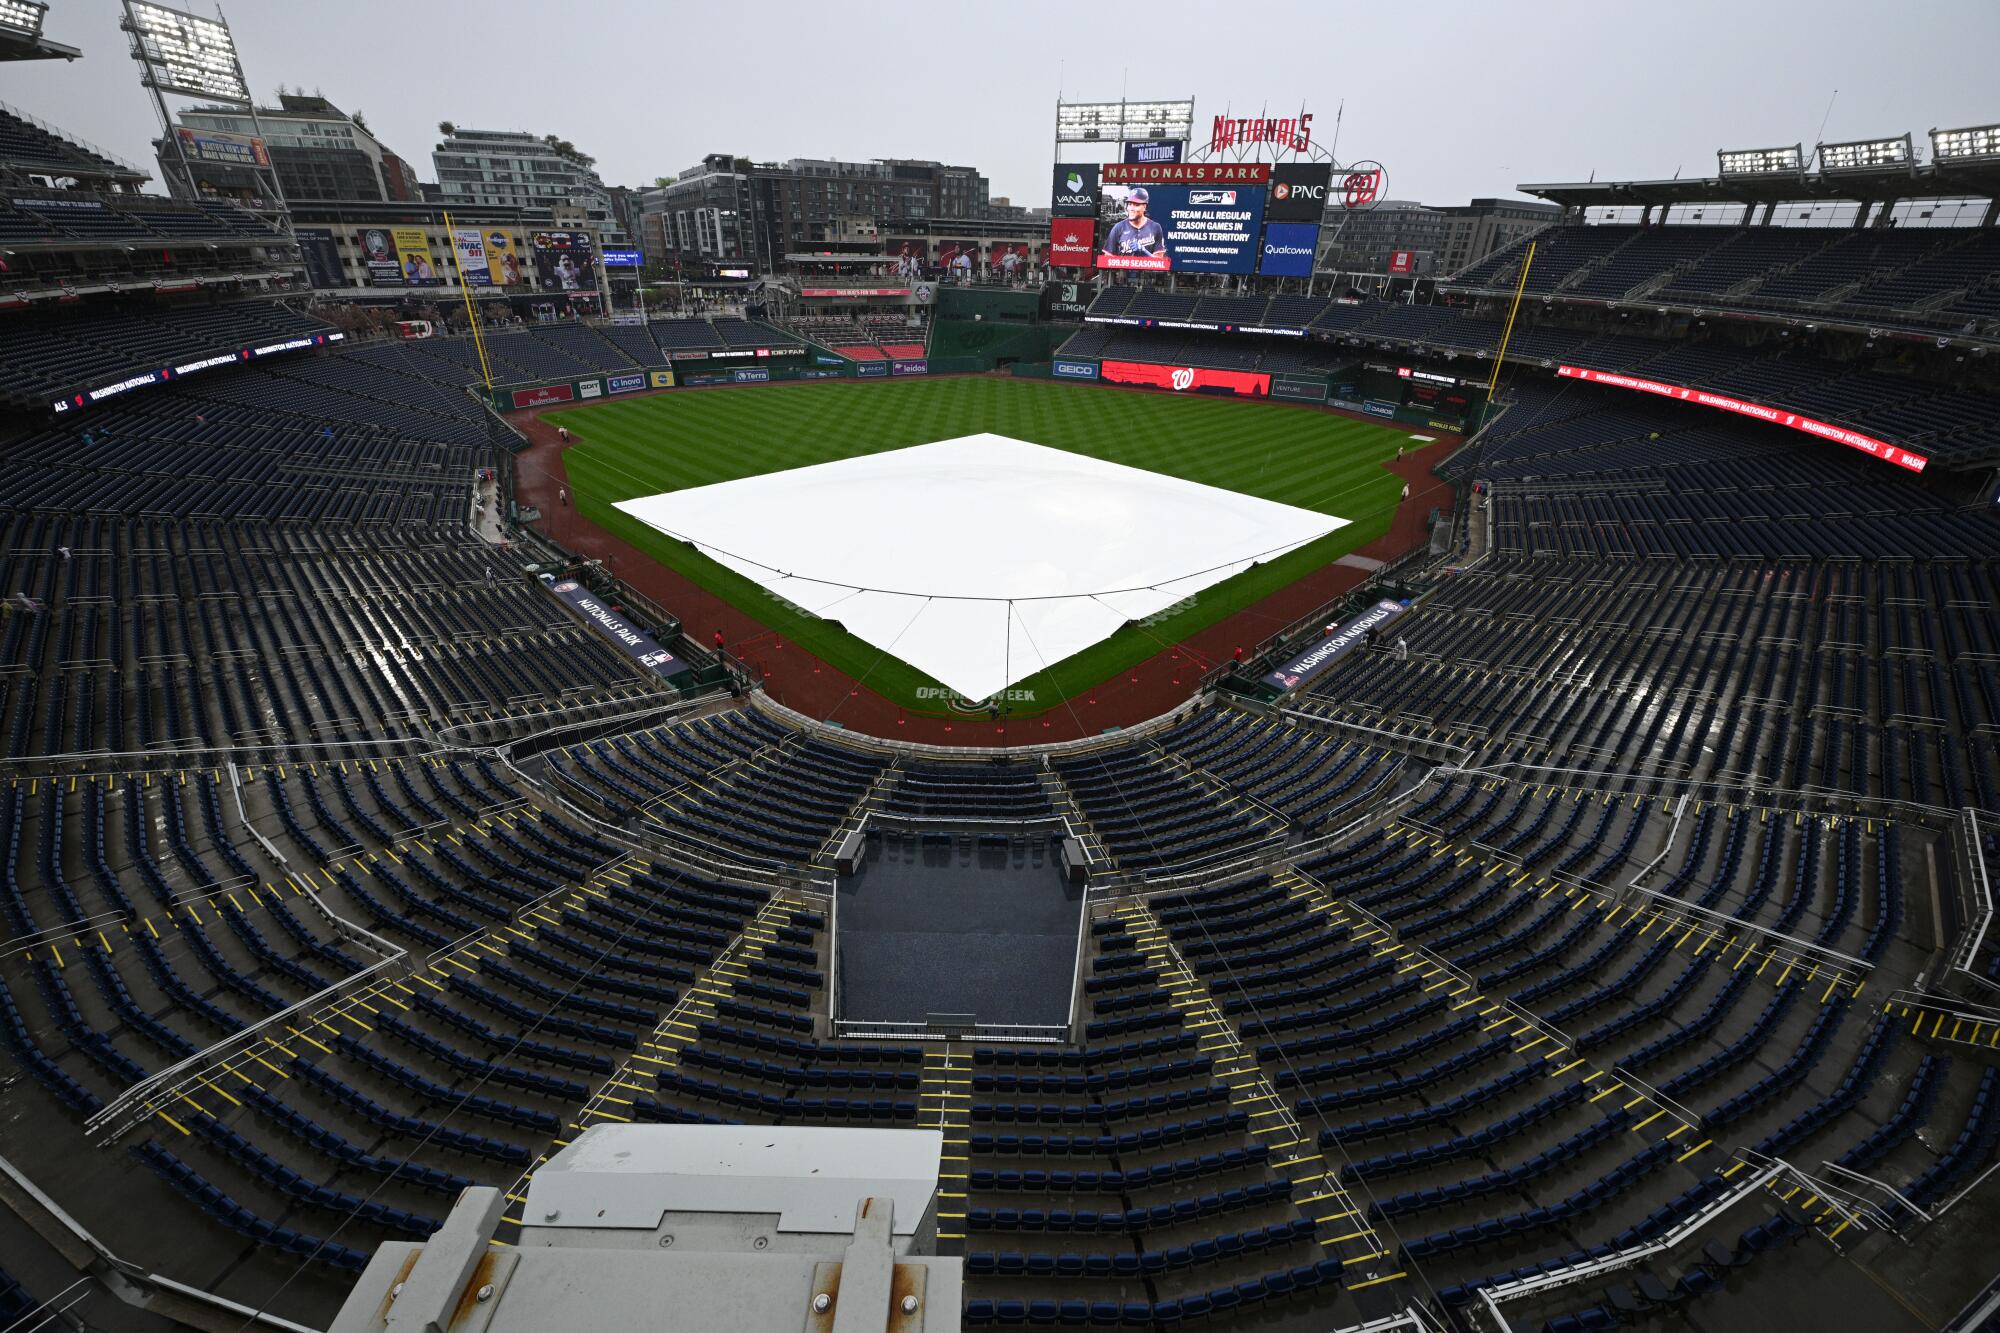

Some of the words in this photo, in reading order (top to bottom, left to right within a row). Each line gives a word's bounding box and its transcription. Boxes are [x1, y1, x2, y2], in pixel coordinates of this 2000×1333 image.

[1211, 114, 1313, 152] NATIONALS
[1138, 146, 1175, 160] NATITUDE
[1108, 168, 1205, 178] NATIONALS
[1214, 168, 1260, 178] PARK
[1291, 185, 1325, 199] PNC
[1056, 195, 1092, 204] VANDA
[1171, 210, 1201, 219] STREAM
[1202, 211, 1215, 219] ALL
[1215, 211, 1252, 220] REGULAR
[1176, 221, 1207, 230] SEASON
[1206, 222, 1234, 231] GAMES
[1234, 222, 1243, 231] IN
[1167, 231, 1207, 240] NATIONALS
[1208, 232, 1250, 241] TERRITORY
[1052, 243, 1090, 253] Budweiser
[1175, 246, 1239, 255] NATIONALS.COM/WATCH
[1265, 244, 1313, 256] Qualcomm
[1107, 259, 1130, 267] $99.99
[1130, 260, 1165, 268] SEASONAL
[1051, 303, 1086, 312] BETMGM
[1113, 317, 1139, 325] NATIONALS
[1273, 328, 1303, 336] NATIONALS
[254, 343, 286, 356] WASHINGTON
[286, 338, 312, 349] NATIONALS
[174, 360, 209, 375] WASHINGTON
[207, 353, 237, 366] NATIONALS
[903, 364, 926, 372] leidos
[1058, 365, 1092, 375] GEICO
[1558, 367, 1571, 375] ALS
[89, 382, 127, 400] WASHINGTON
[125, 373, 156, 391] NATIONALS
[580, 382, 599, 390] GDIT
[619, 377, 641, 387] Inova
[1595, 373, 1637, 387] WASHINGTON
[1637, 381, 1672, 394] NATIONALS
[54, 400, 68, 412] ALS
[1698, 394, 1740, 410] WASHINGTON
[1740, 403, 1778, 420] NATIONALS
[1801, 420, 1845, 440] WASHINGTON
[1844, 432, 1878, 452] NATIONALS
[577, 598, 622, 631] NATIONALS
[614, 628, 643, 646] PARK
[1289, 634, 1350, 674] WASHINGTON
[1344, 609, 1389, 641] NATIONALS
[637, 653, 658, 667] MLB
